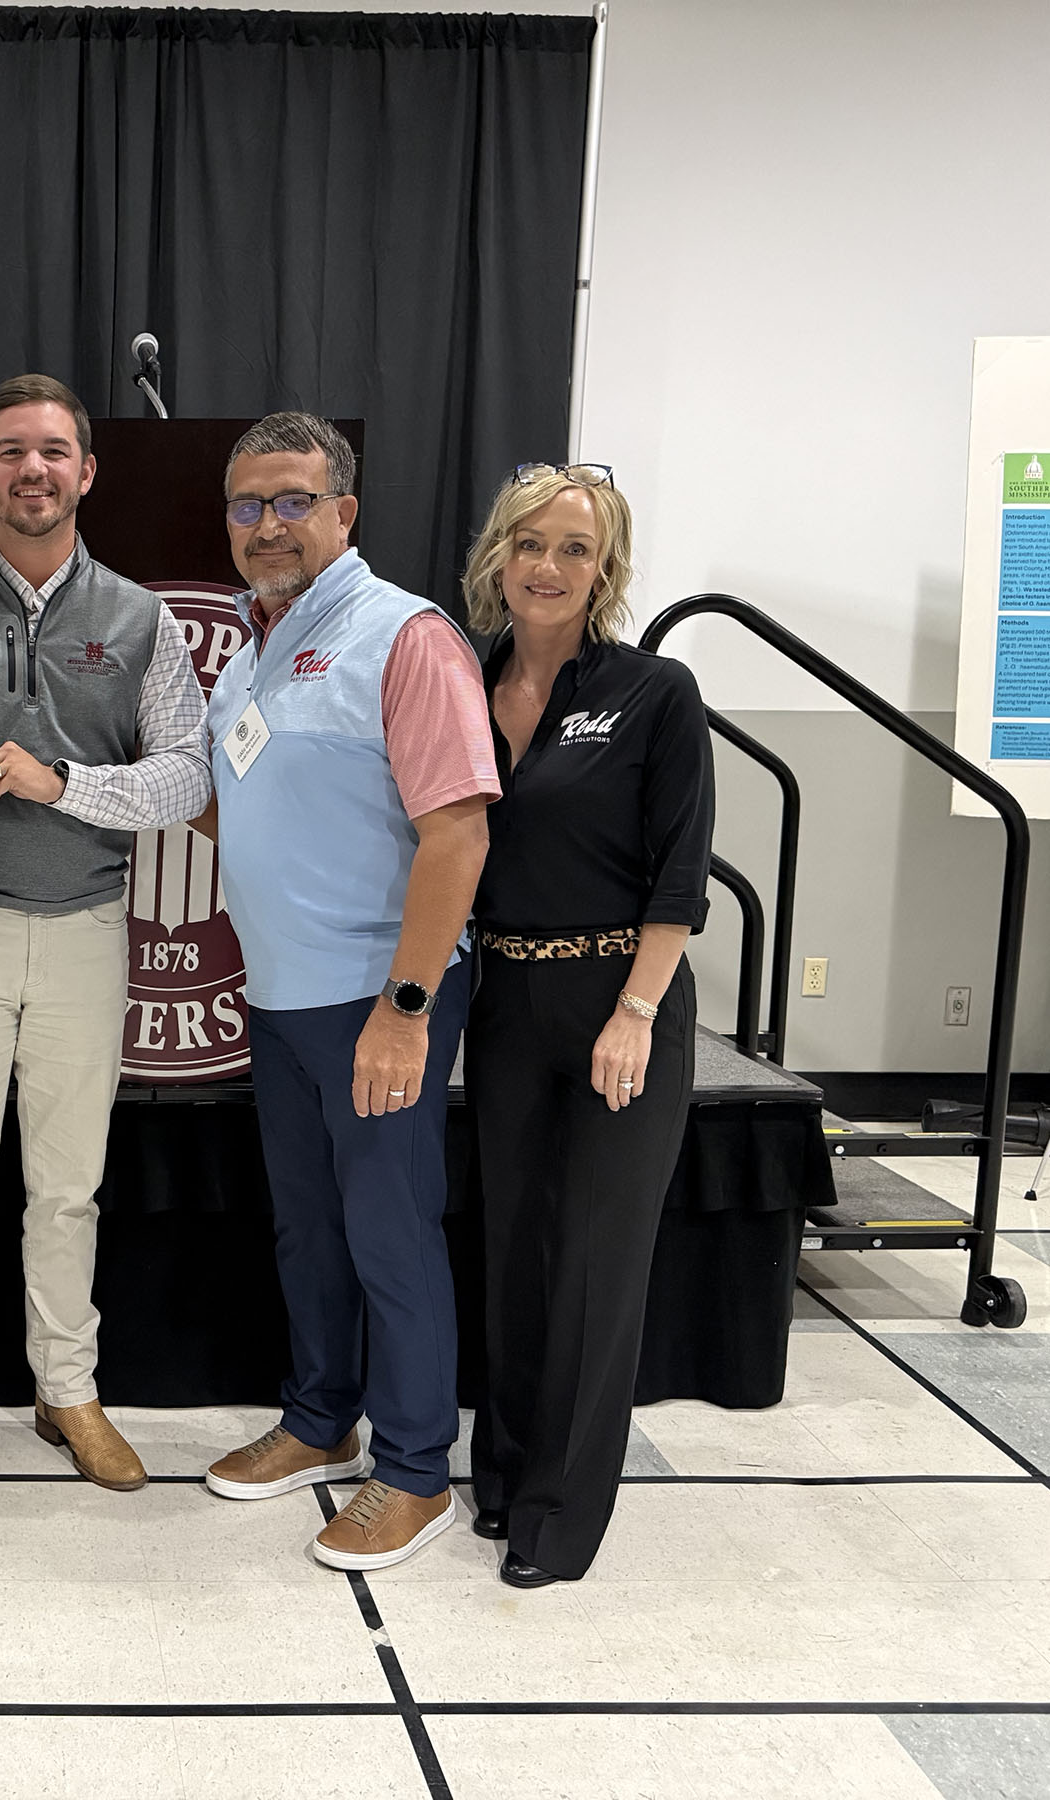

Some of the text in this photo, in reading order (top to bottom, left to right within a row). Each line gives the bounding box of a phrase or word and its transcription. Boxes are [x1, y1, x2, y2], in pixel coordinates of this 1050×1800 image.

[290, 649, 342, 677] Redd
[561, 710, 622, 741] Redd
[139, 942, 200, 973] 1878
